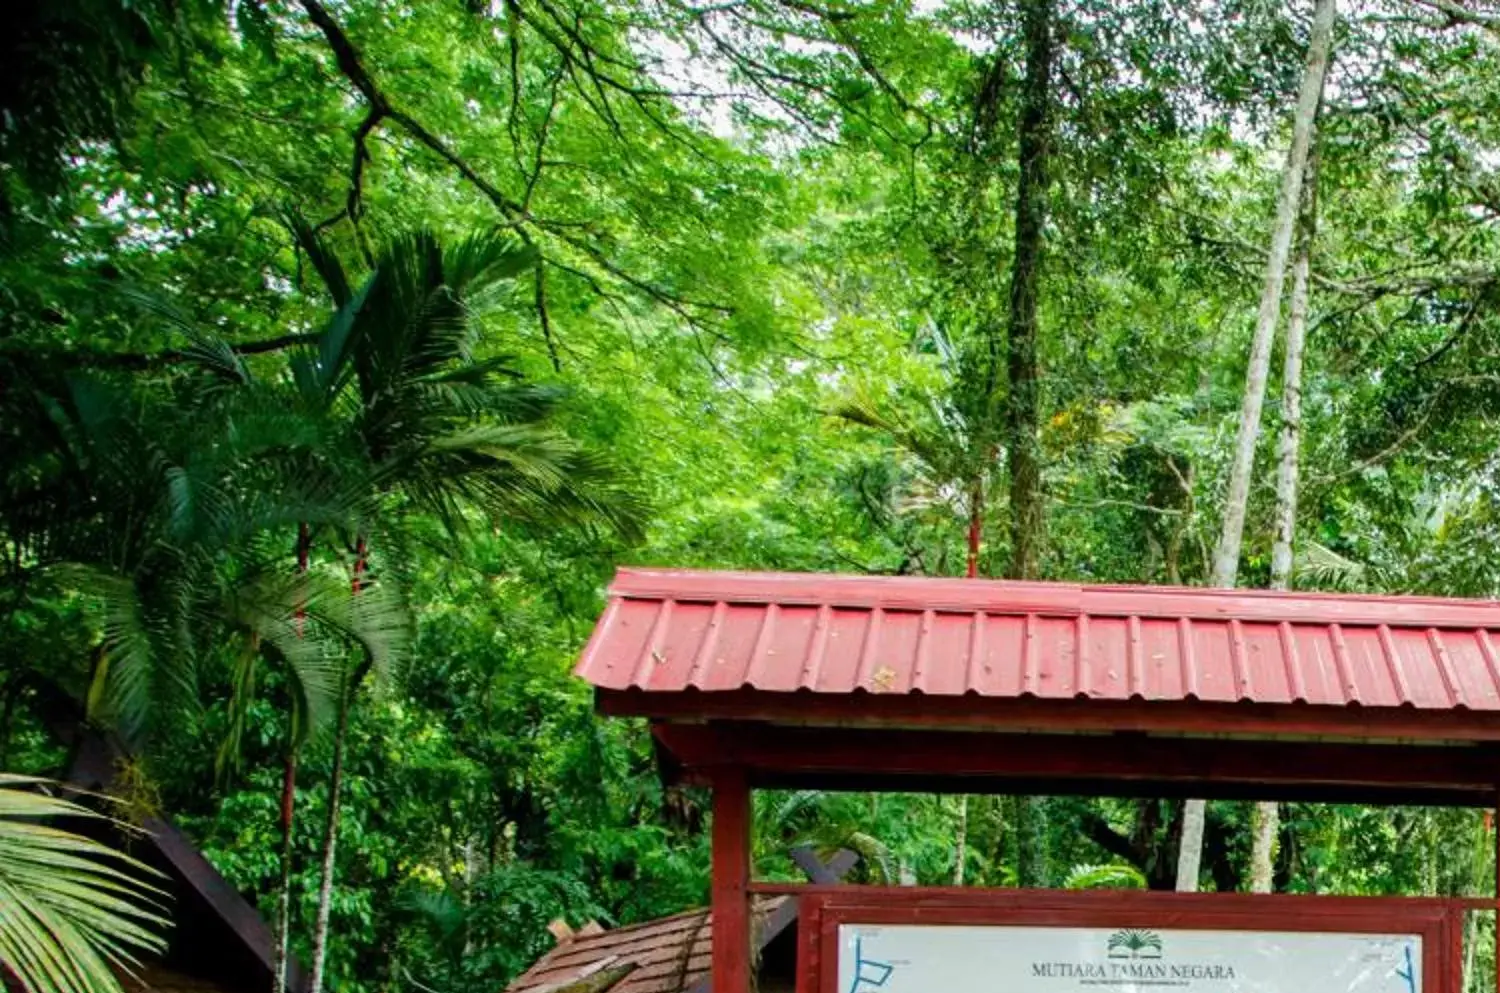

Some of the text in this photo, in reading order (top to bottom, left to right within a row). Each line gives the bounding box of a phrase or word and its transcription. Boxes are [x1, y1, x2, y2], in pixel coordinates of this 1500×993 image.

[1032, 963, 1236, 979] MUTIARA TAMAN NEGARA
